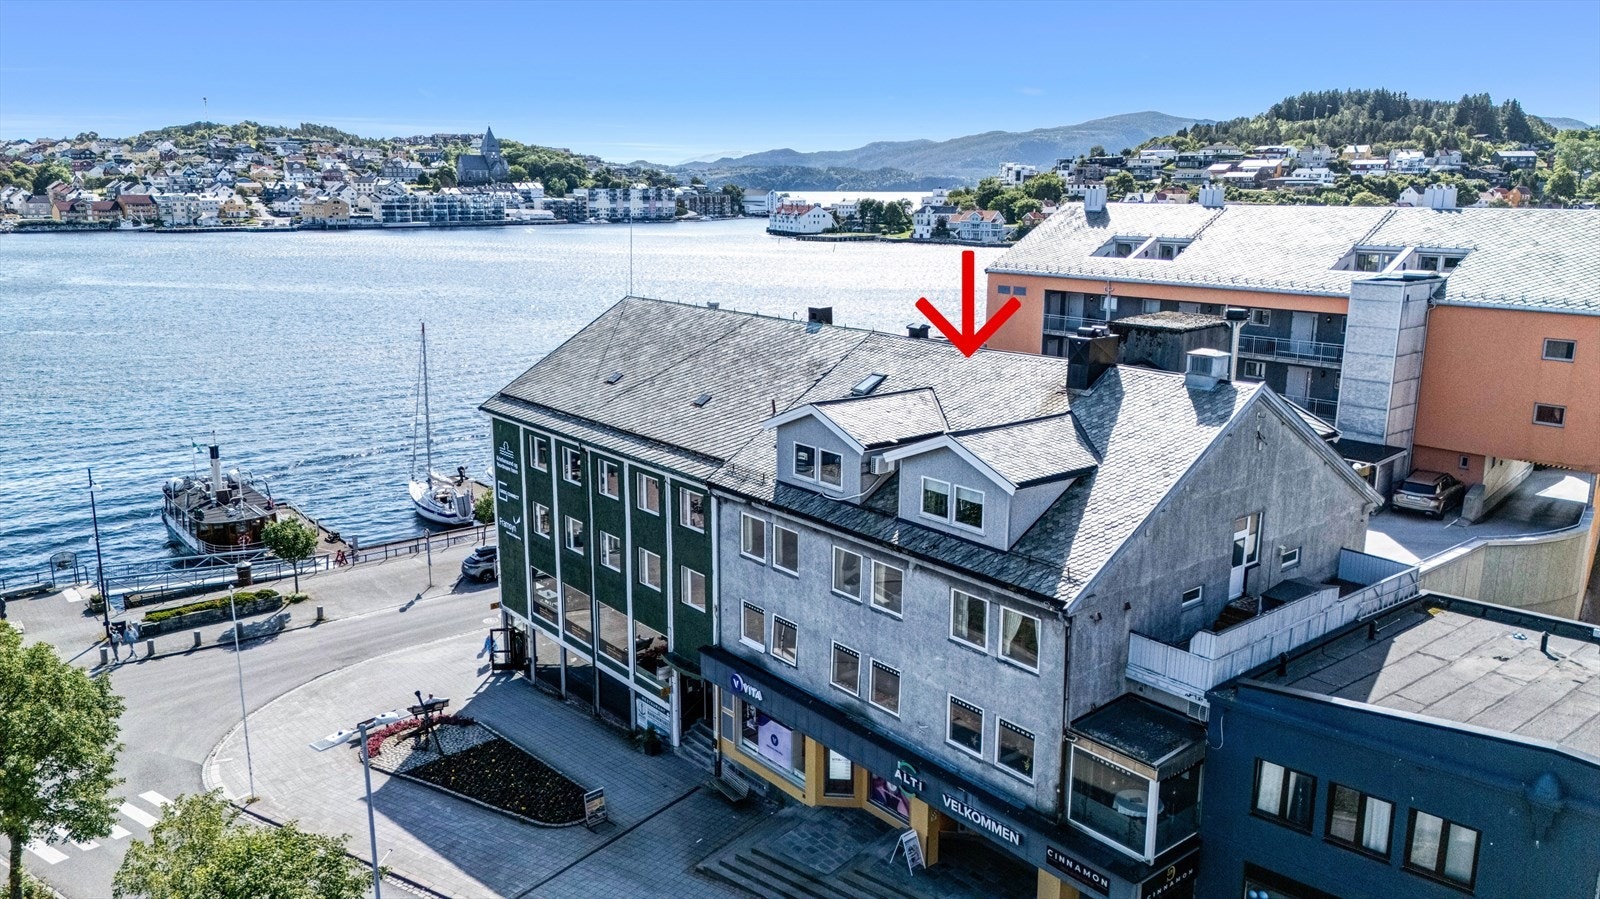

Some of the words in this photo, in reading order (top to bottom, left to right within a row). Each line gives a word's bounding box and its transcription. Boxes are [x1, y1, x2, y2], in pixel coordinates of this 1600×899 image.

[743, 682, 763, 701] VITA
[894, 769, 923, 791] ALTI
[942, 793, 1020, 846] VELKOMMEN
[1047, 848, 1108, 888] CINNAMON
